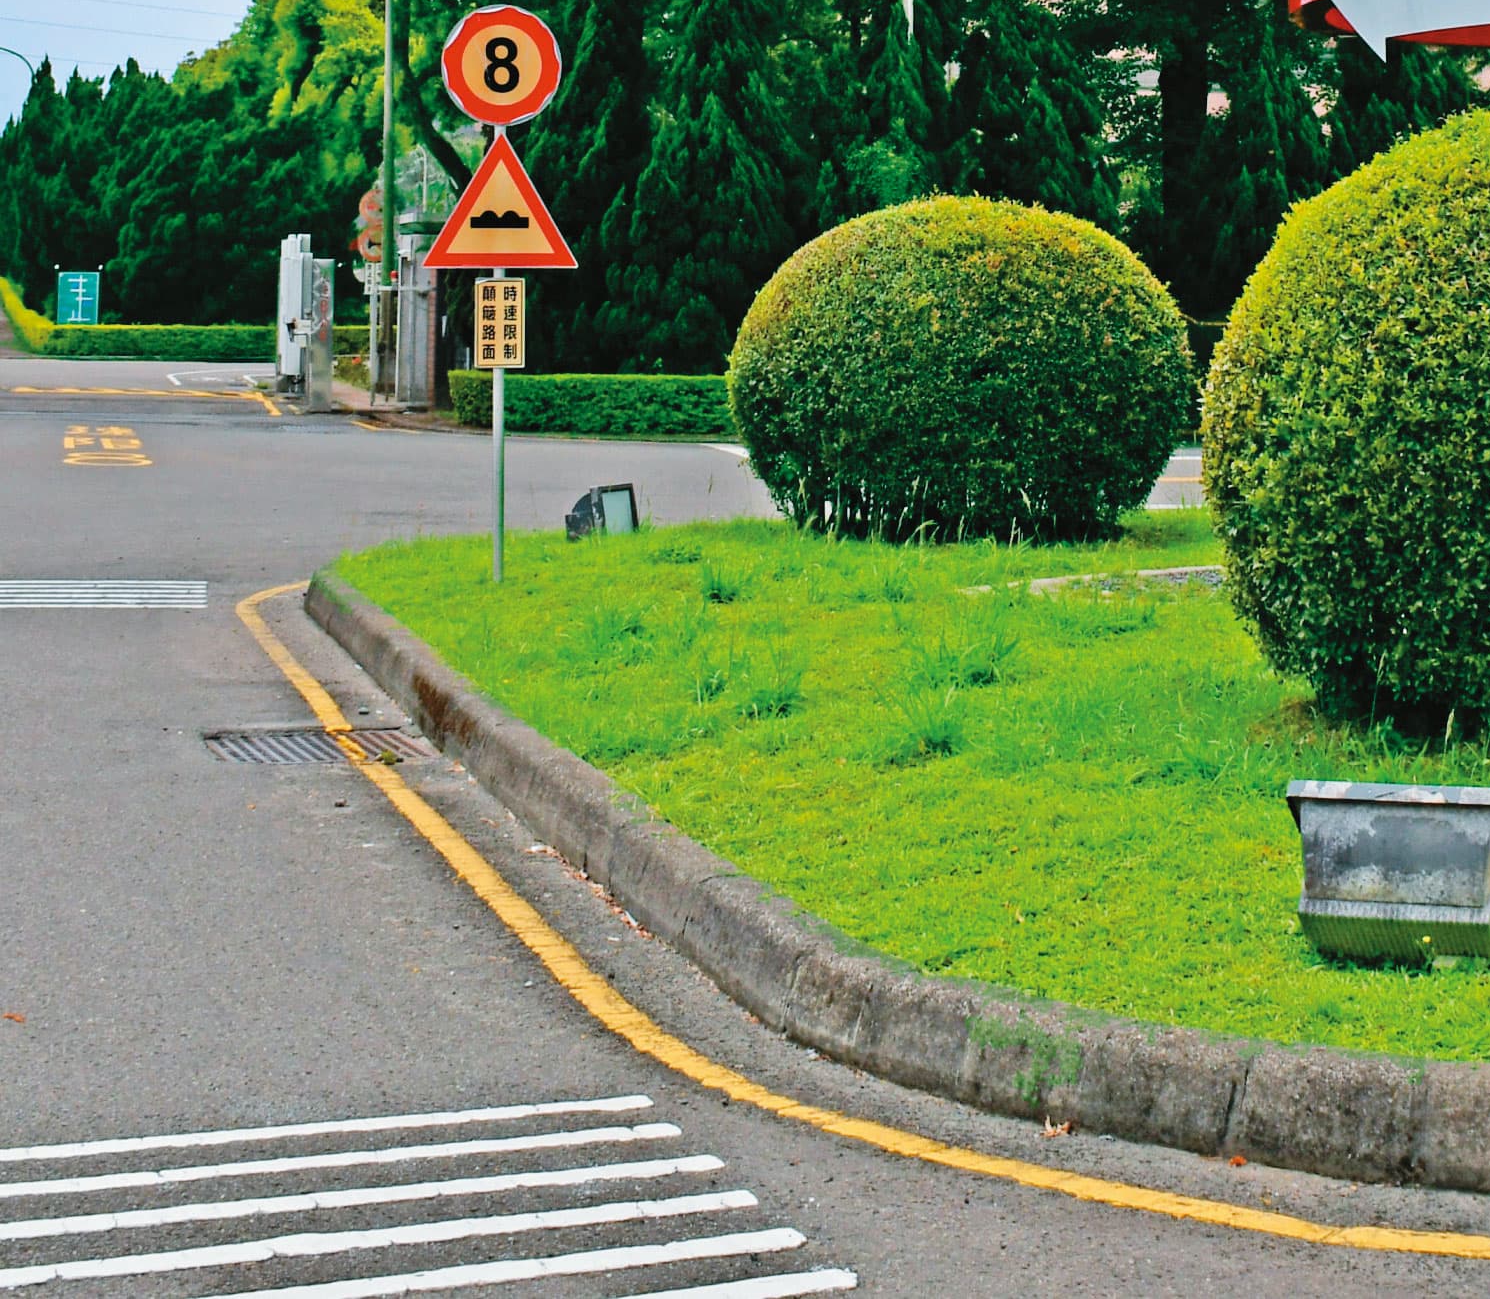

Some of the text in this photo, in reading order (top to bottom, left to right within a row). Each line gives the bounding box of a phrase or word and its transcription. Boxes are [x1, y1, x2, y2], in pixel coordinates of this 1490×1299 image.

[484, 37, 520, 94] 8
[503, 286, 517, 359] 時速限制
